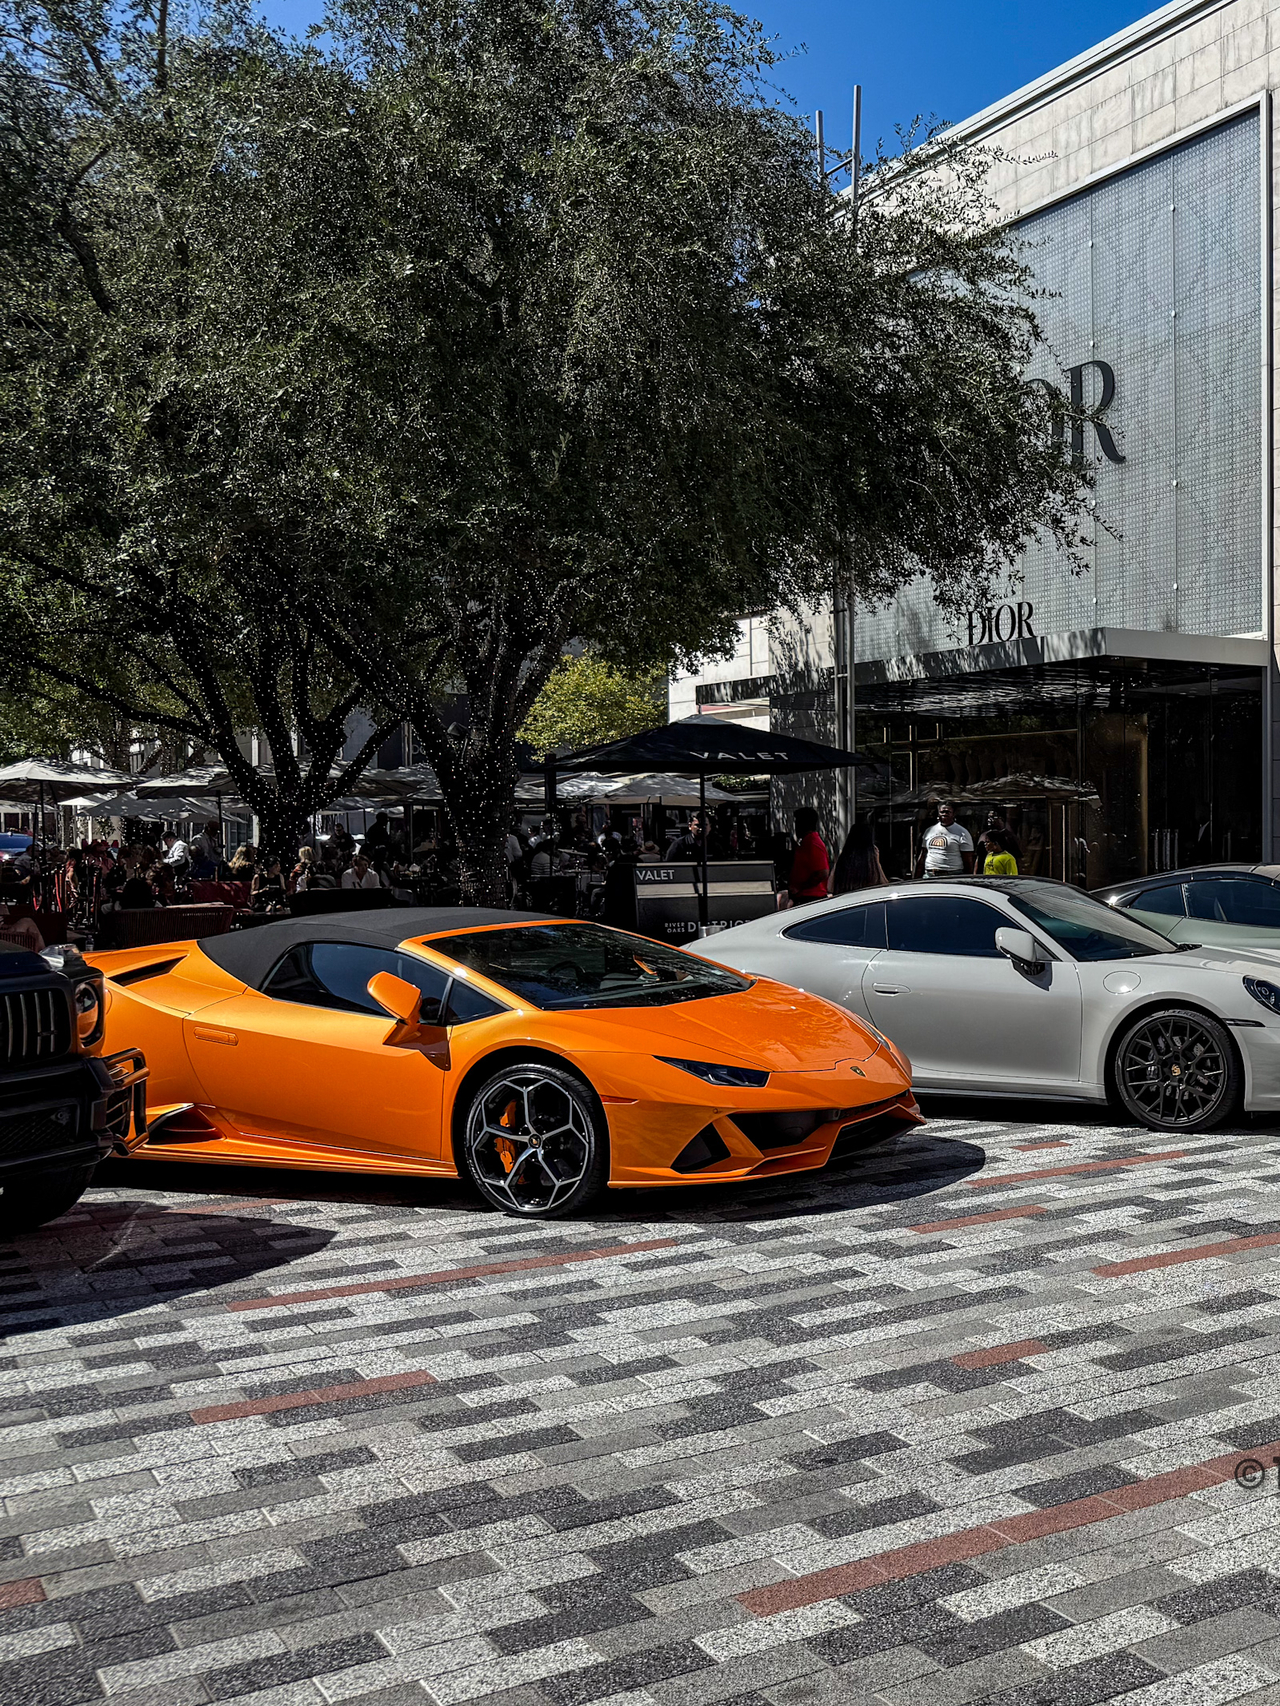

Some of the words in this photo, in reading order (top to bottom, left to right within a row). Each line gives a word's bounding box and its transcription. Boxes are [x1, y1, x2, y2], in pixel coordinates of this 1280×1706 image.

[967, 601, 1037, 646] DIOR
[689, 751, 789, 760] VALET
[636, 869, 675, 881] VALET
